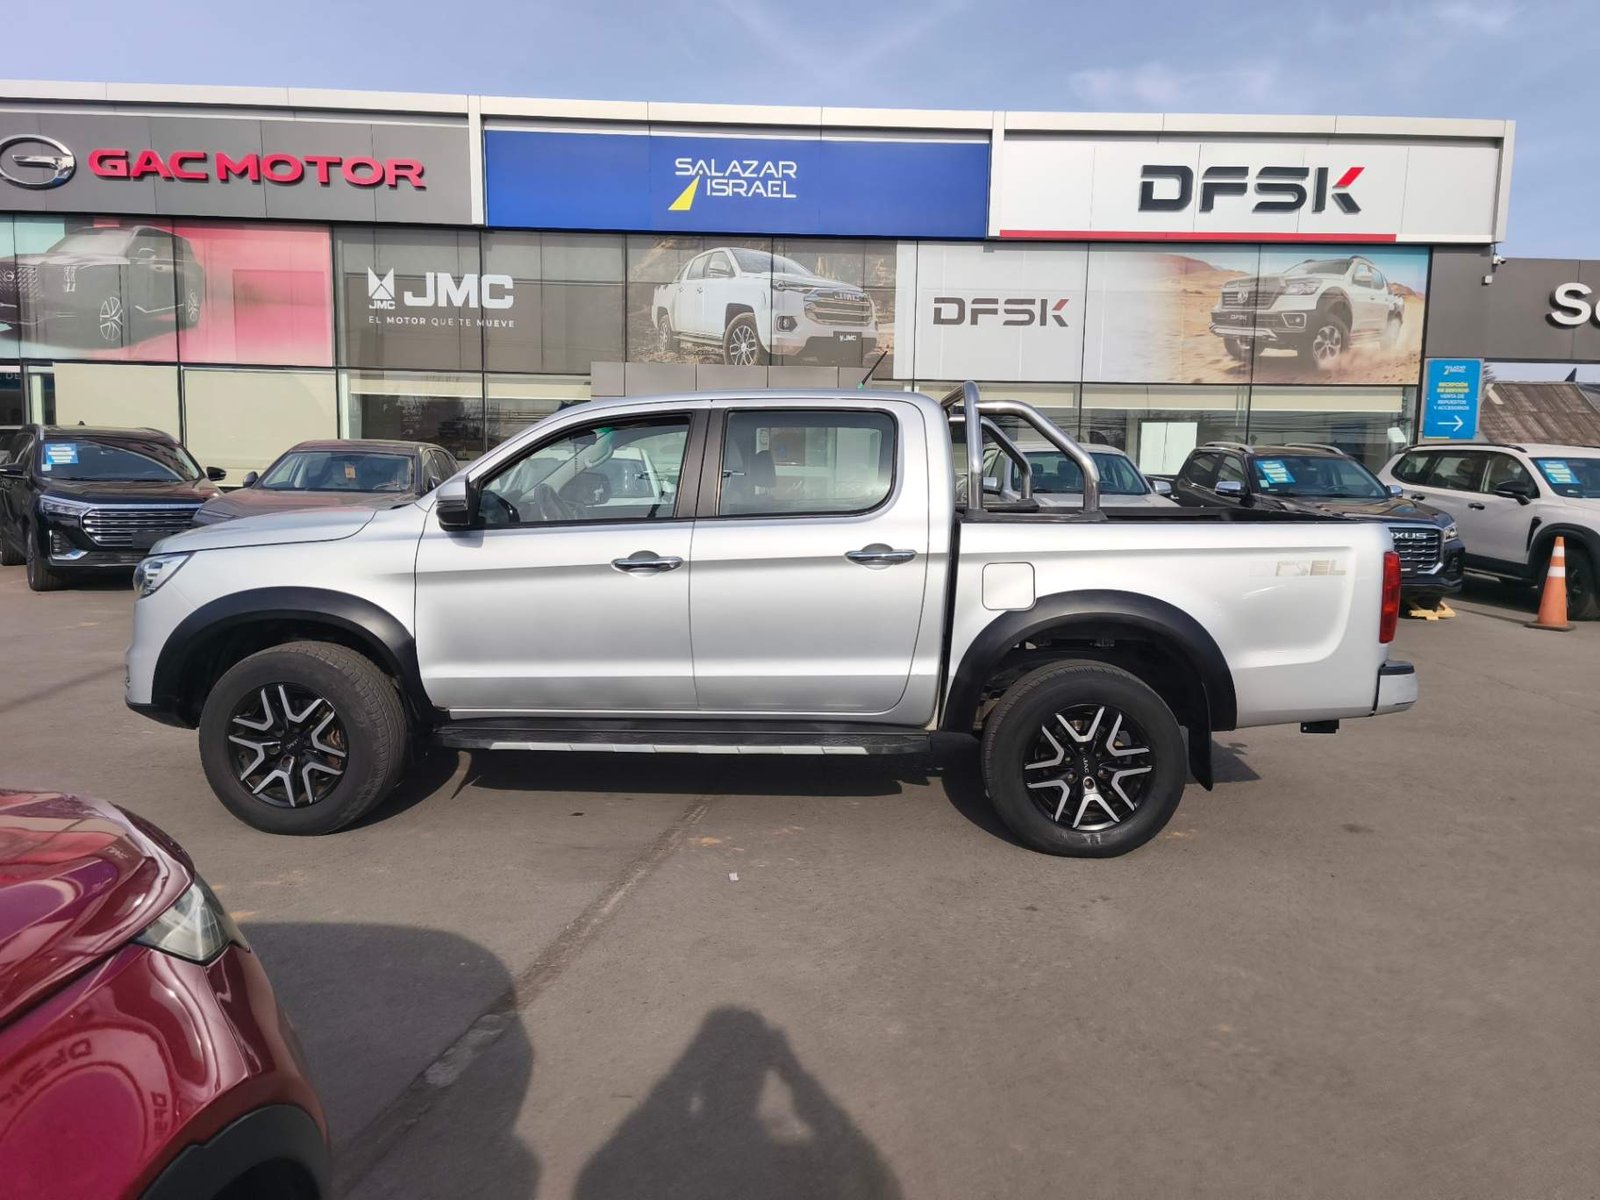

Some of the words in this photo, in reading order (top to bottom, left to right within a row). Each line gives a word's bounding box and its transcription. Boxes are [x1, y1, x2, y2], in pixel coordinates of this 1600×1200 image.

[88, 149, 209, 181] GAC
[215, 152, 427, 191] MOTOR
[675, 157, 798, 179] SALAZAR
[706, 178, 798, 198] ISRAEL
[1138, 164, 1366, 214] DFSK
[403, 271, 514, 309] JMC
[368, 299, 396, 310] JMC
[932, 296, 1070, 327] DFSK
[1550, 281, 1600, 327] S
[368, 315, 382, 324] EL
[386, 316, 427, 325] MOTOR
[431, 317, 454, 327] QUE
[458, 318, 471, 327] TE
[476, 318, 515, 328] MUEVE
[1391, 532, 1428, 540] XUS
